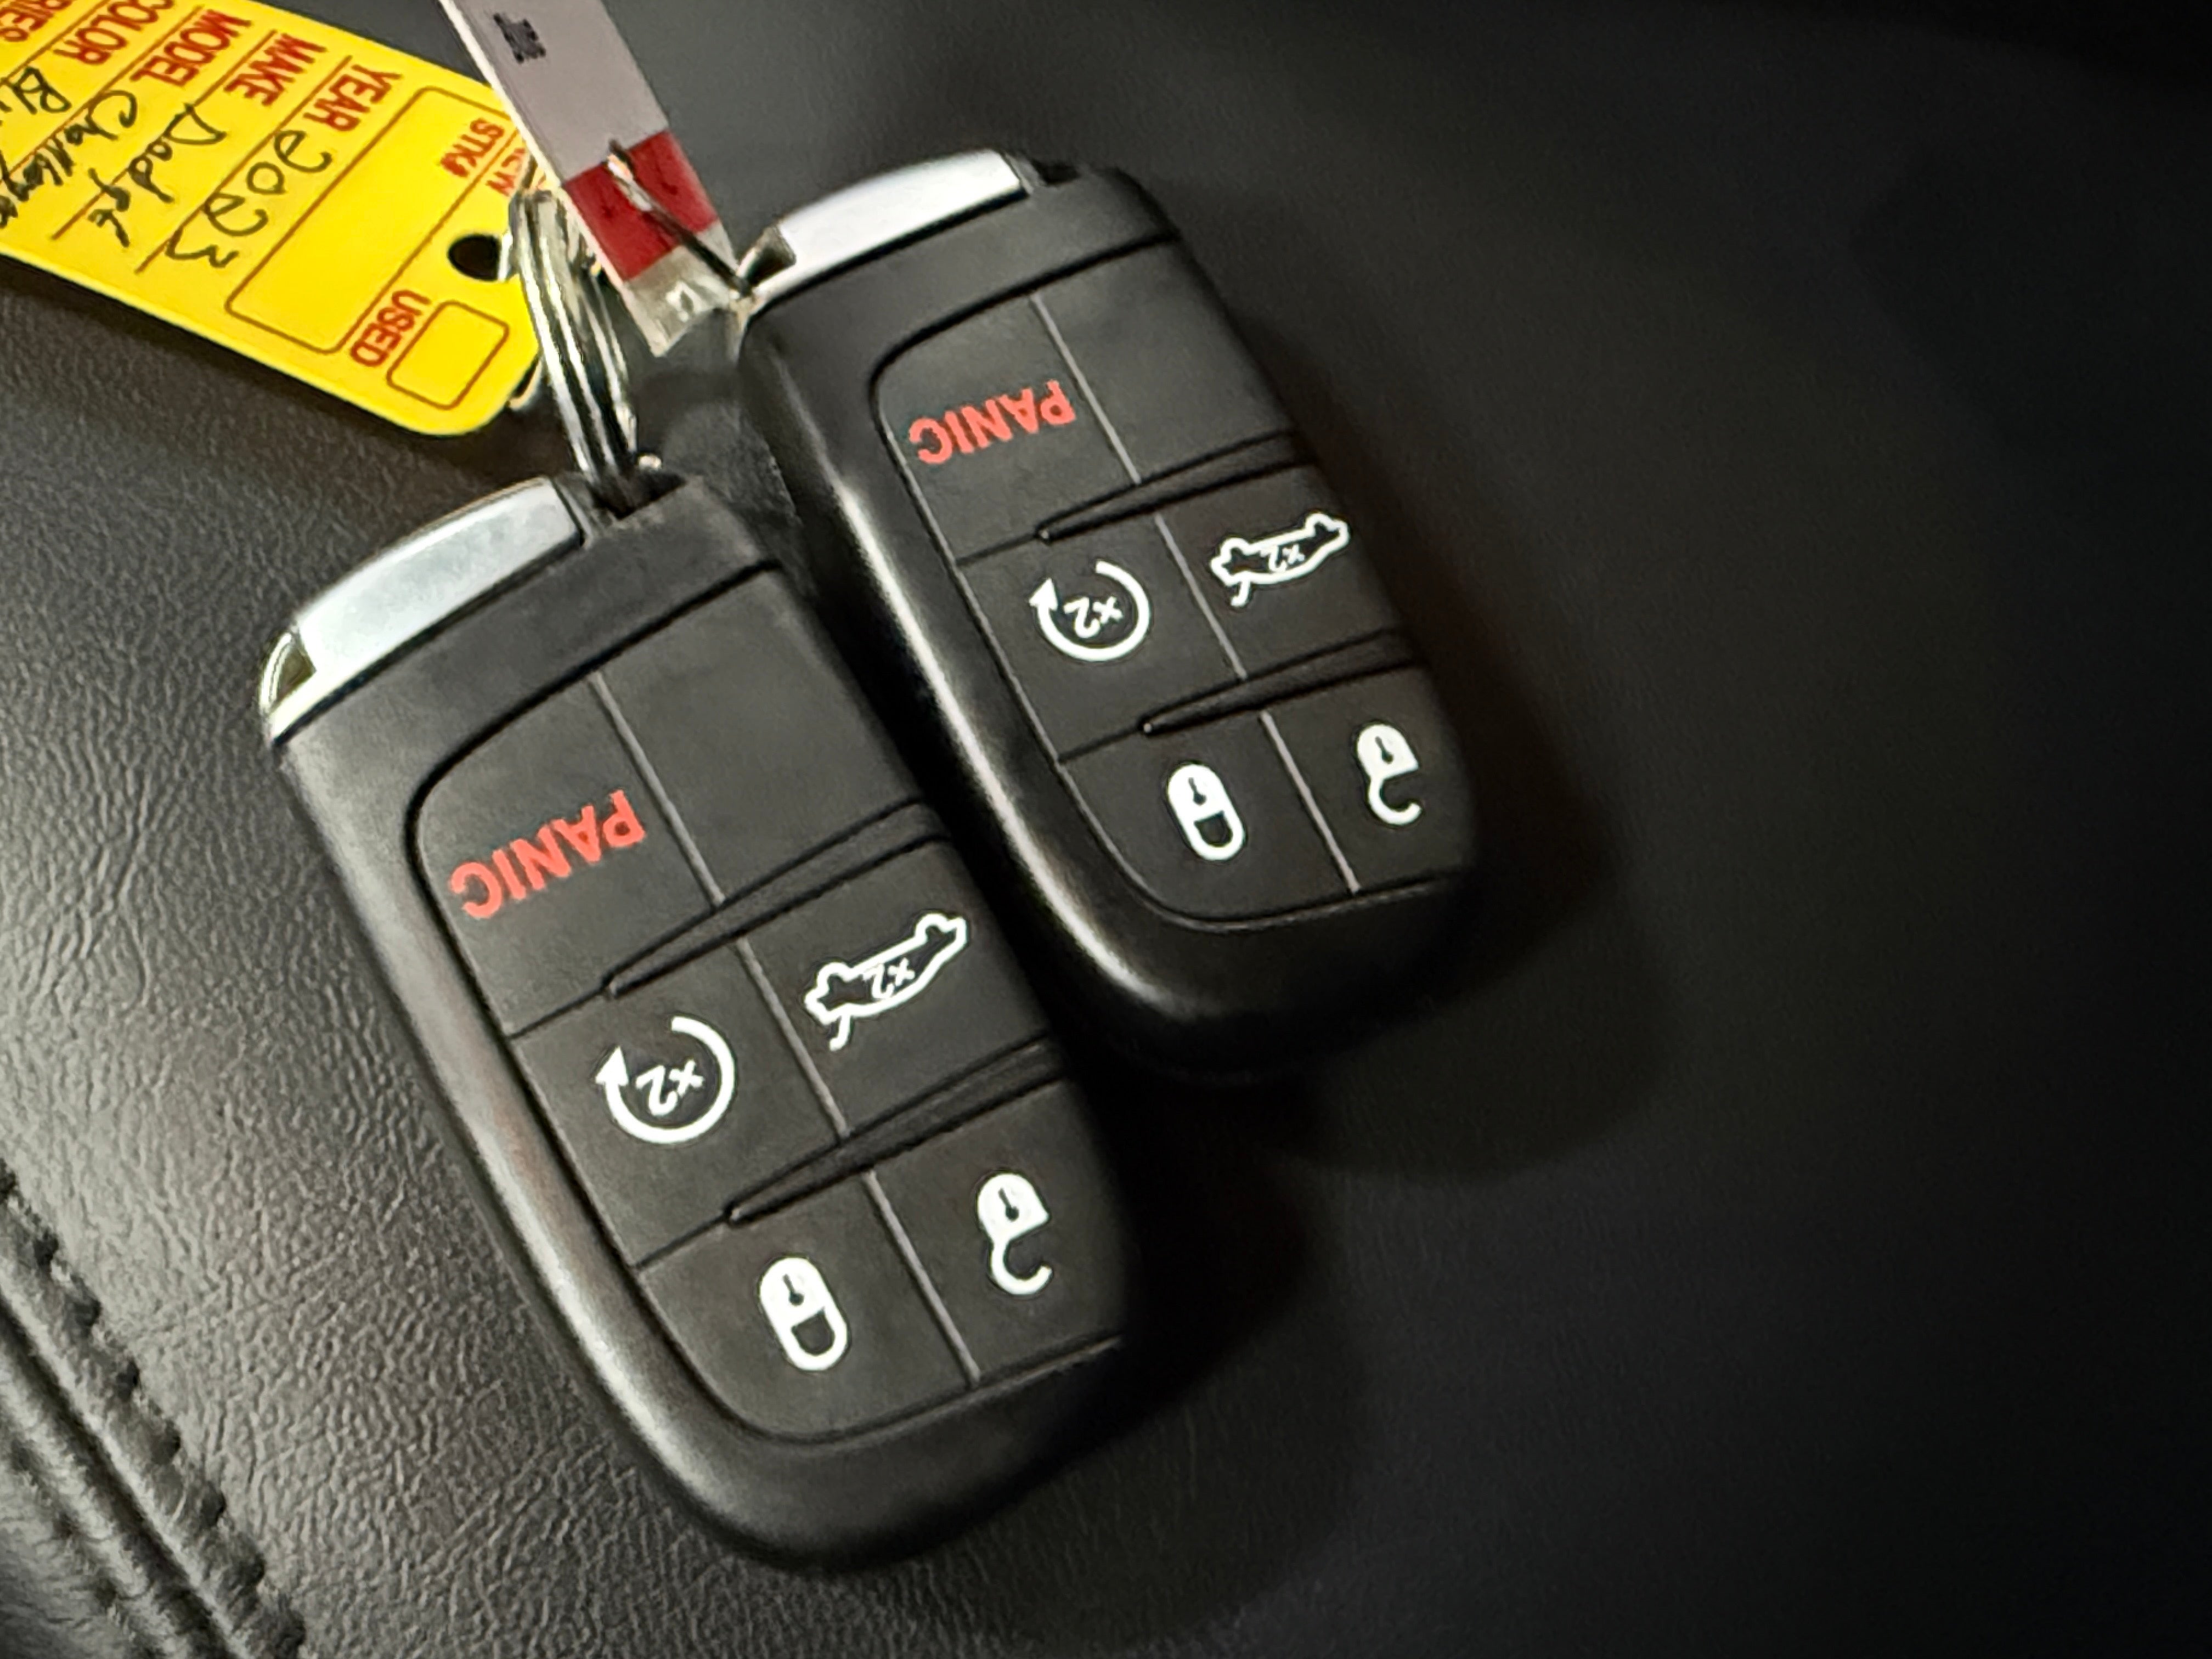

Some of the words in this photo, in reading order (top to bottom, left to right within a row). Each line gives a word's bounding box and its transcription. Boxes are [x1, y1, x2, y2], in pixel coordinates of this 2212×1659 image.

[129, 9, 251, 87] MODEL
[223, 32, 328, 106] MAKE
[0, 66, 72, 124] Bl
[303, 64, 403, 131] YEAR
[0, 89, 137, 229] Challenge
[88, 103, 228, 247] Dodge
[441, 118, 505, 177] STK#
[486, 148, 526, 197] EW
[166, 129, 332, 268] 2023
[350, 289, 431, 367] USED
[909, 380, 1076, 464] PANIC
[450, 790, 646, 918] PANIC
